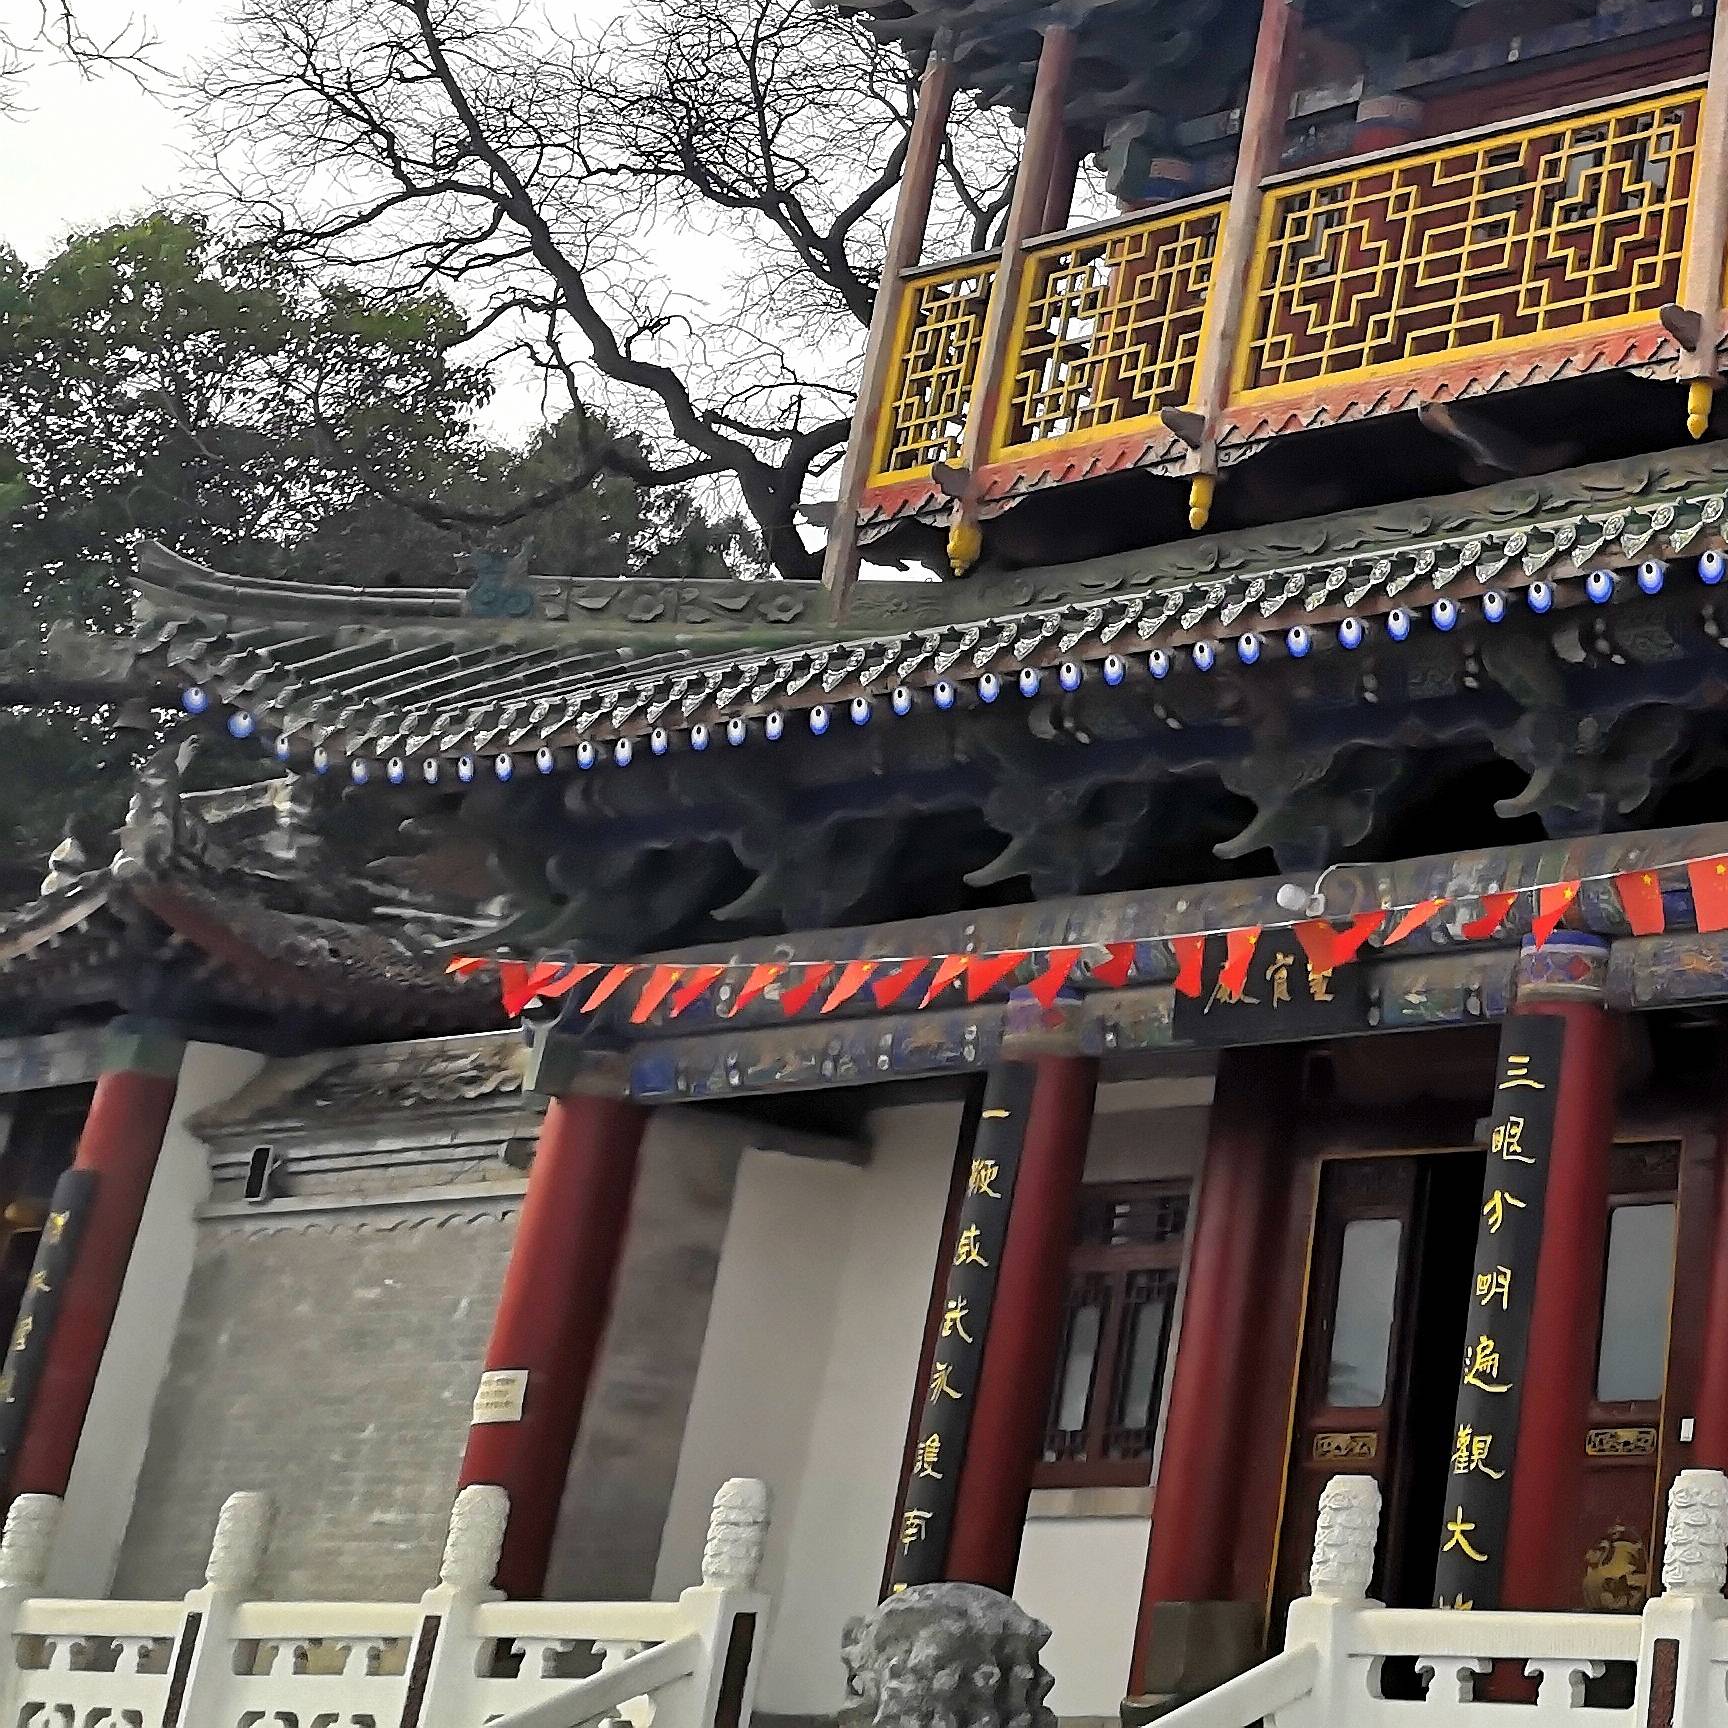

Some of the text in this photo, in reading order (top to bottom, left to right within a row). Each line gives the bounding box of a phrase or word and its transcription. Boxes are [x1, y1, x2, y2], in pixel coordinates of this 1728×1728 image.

[891, 1109, 1012, 1592] 一鞭威武永護南
